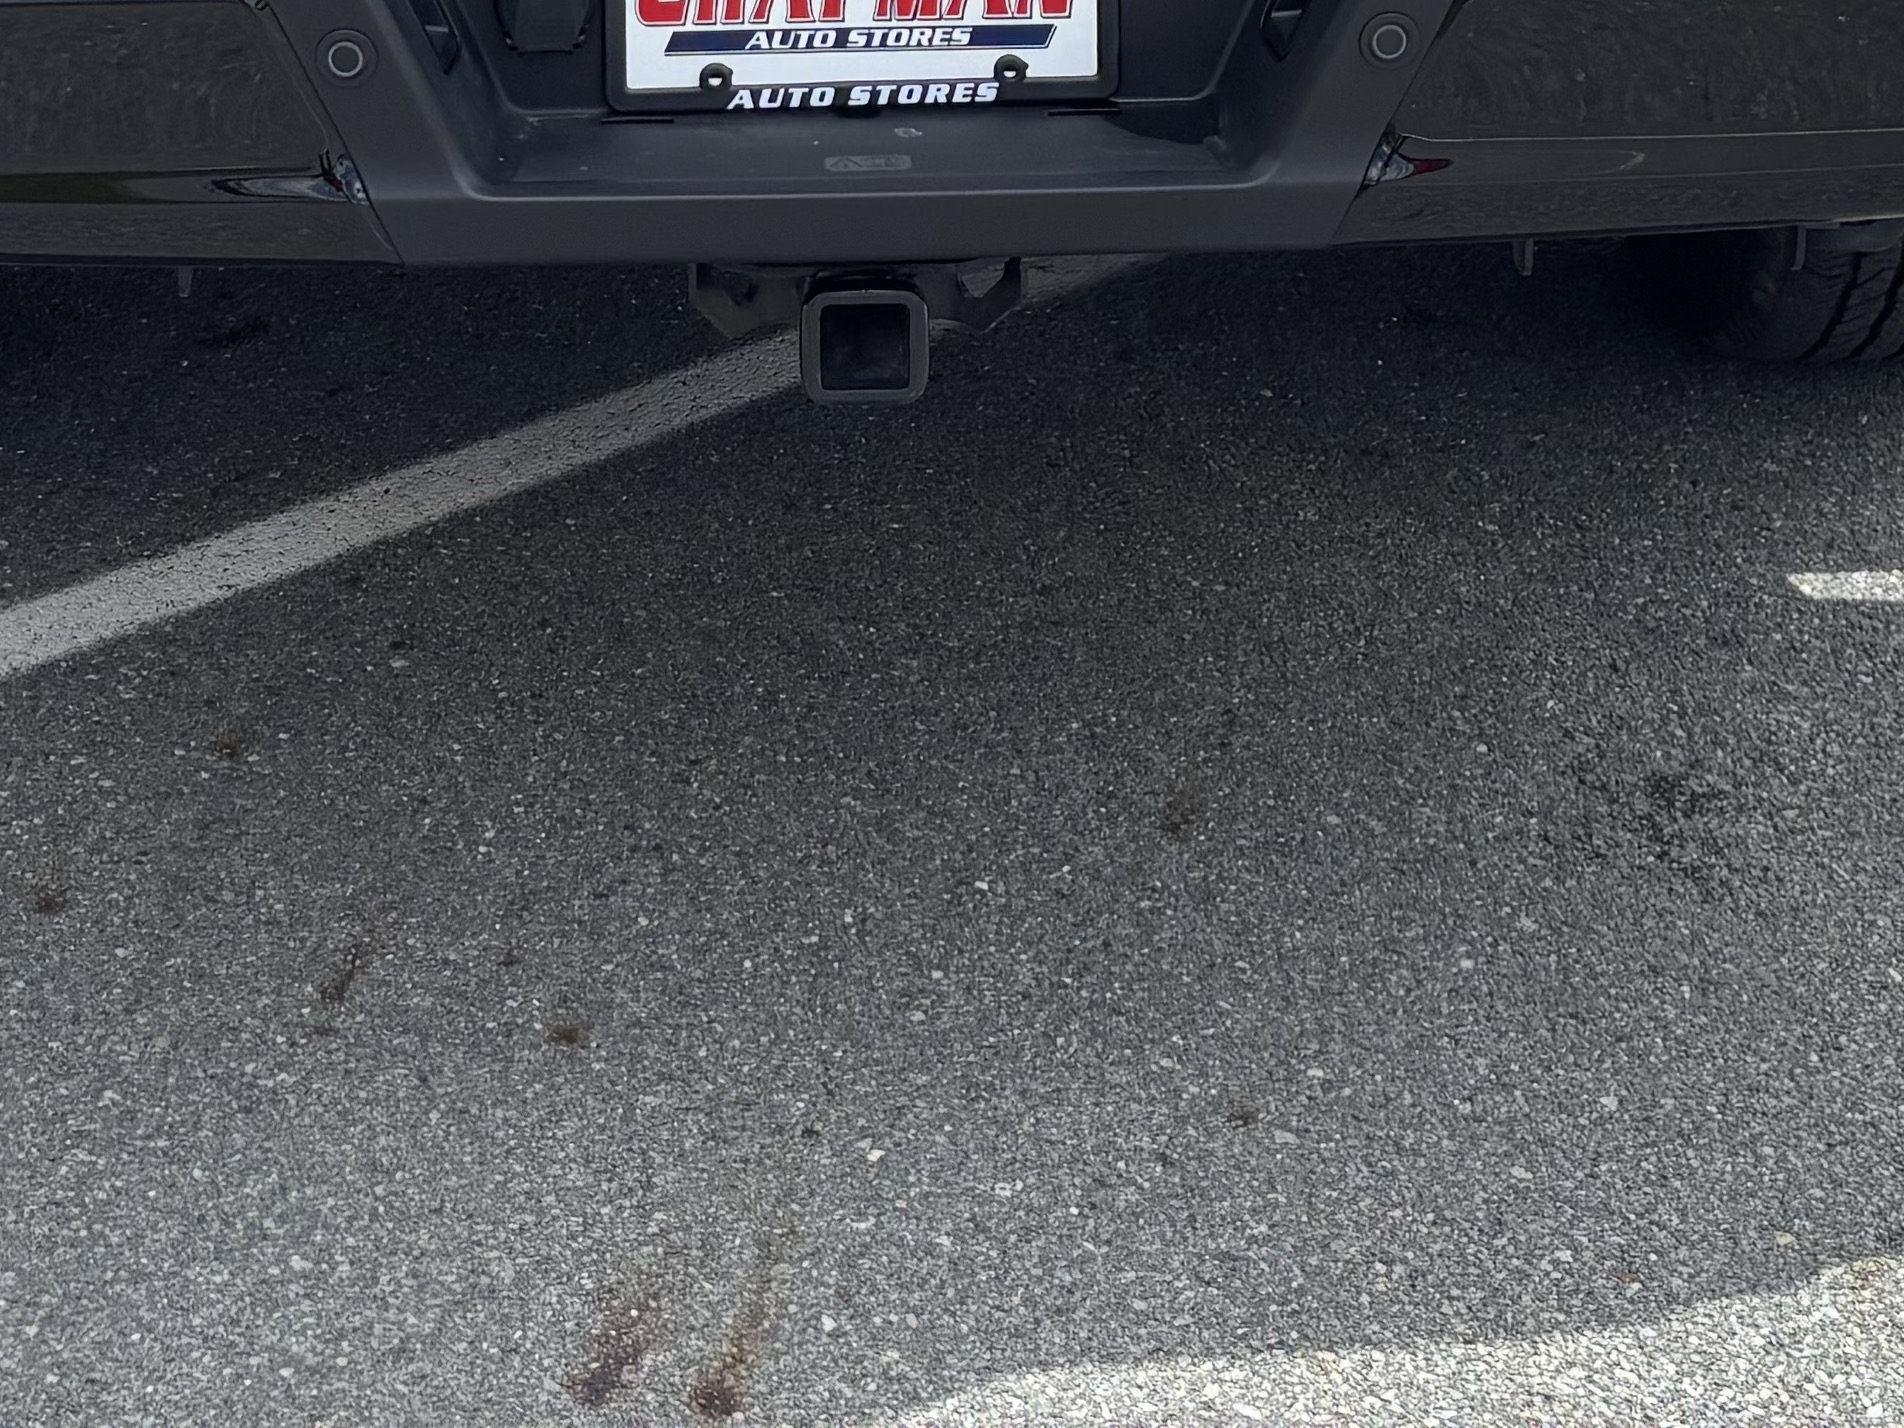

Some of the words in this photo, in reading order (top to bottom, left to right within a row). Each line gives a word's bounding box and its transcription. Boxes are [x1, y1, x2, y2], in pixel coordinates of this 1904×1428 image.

[745, 30, 835, 50] AUTO
[846, 27, 974, 48] STORES
[726, 86, 836, 111] AUTO
[847, 82, 1000, 105] STORES
